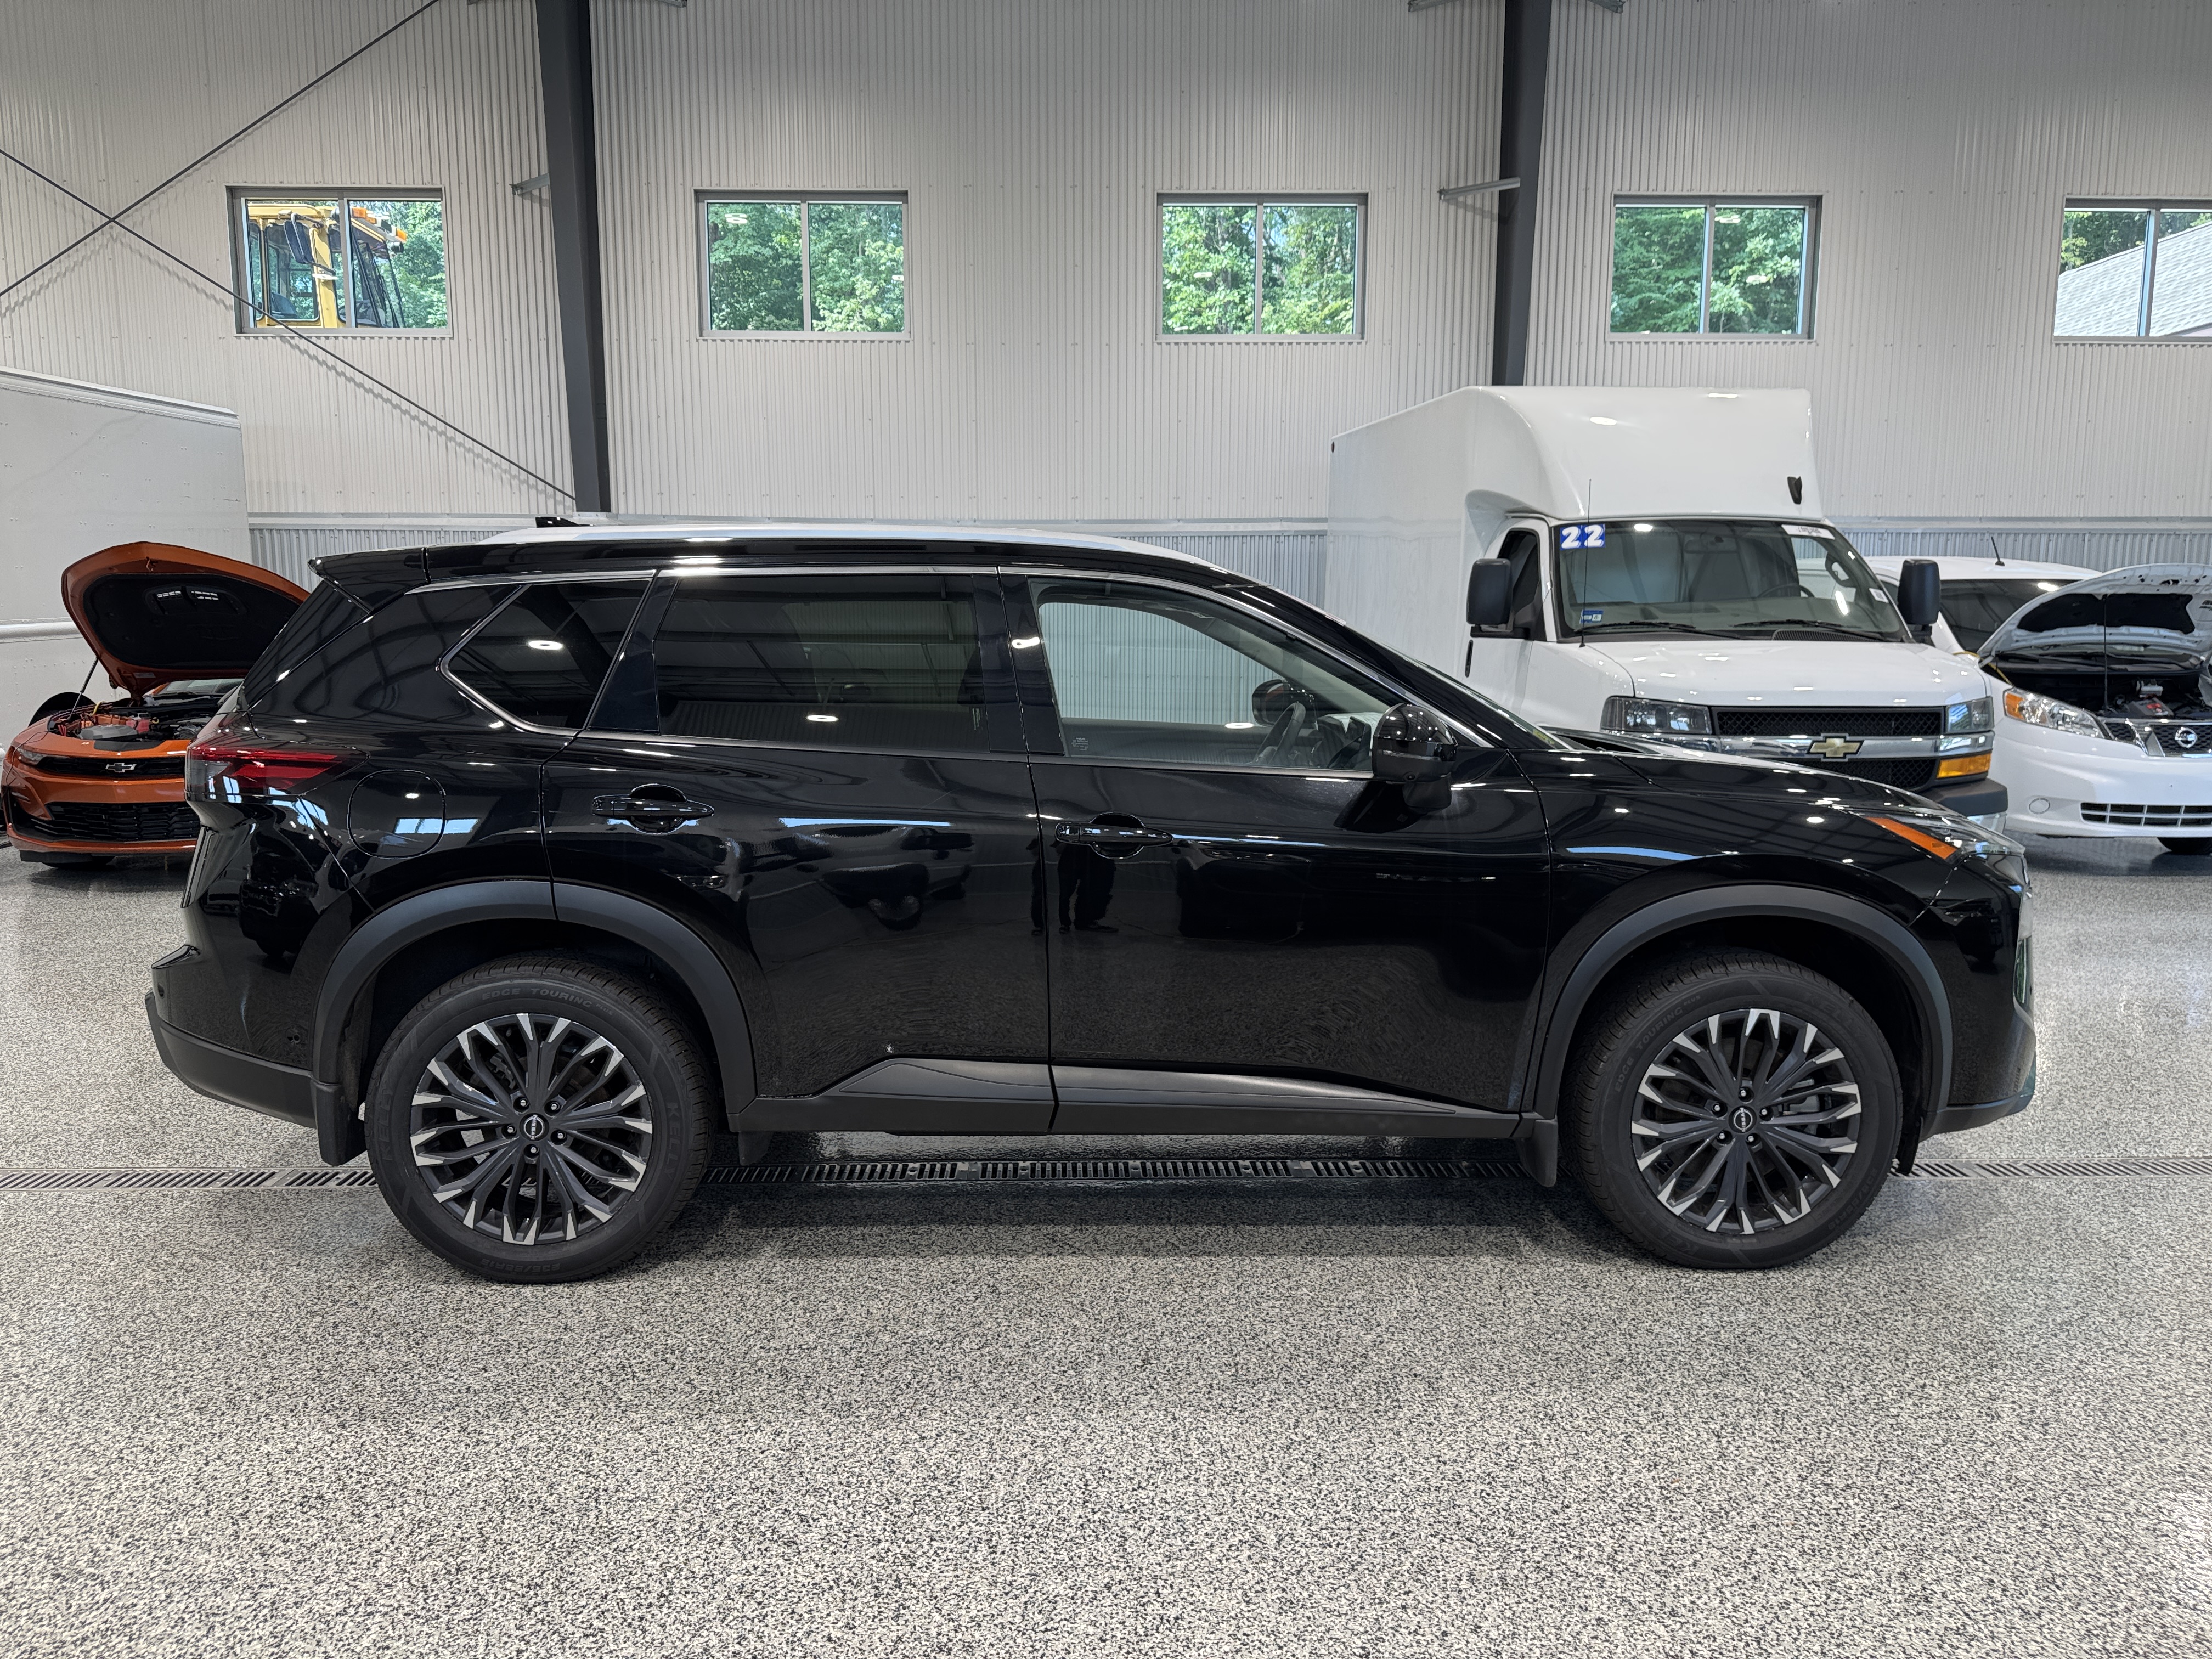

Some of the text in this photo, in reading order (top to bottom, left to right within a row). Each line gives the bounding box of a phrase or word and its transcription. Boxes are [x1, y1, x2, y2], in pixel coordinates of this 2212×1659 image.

[1561, 524, 1604, 550] 22
[482, 988, 521, 1001] EDGE
[530, 988, 593, 1008] TOURING
[1614, 1056, 1635, 1093] EDGE
[1635, 1006, 1684, 1051] TOURING
[530, 1114, 538, 1140] NISSAN
[663, 1102, 681, 1181] KELLY
